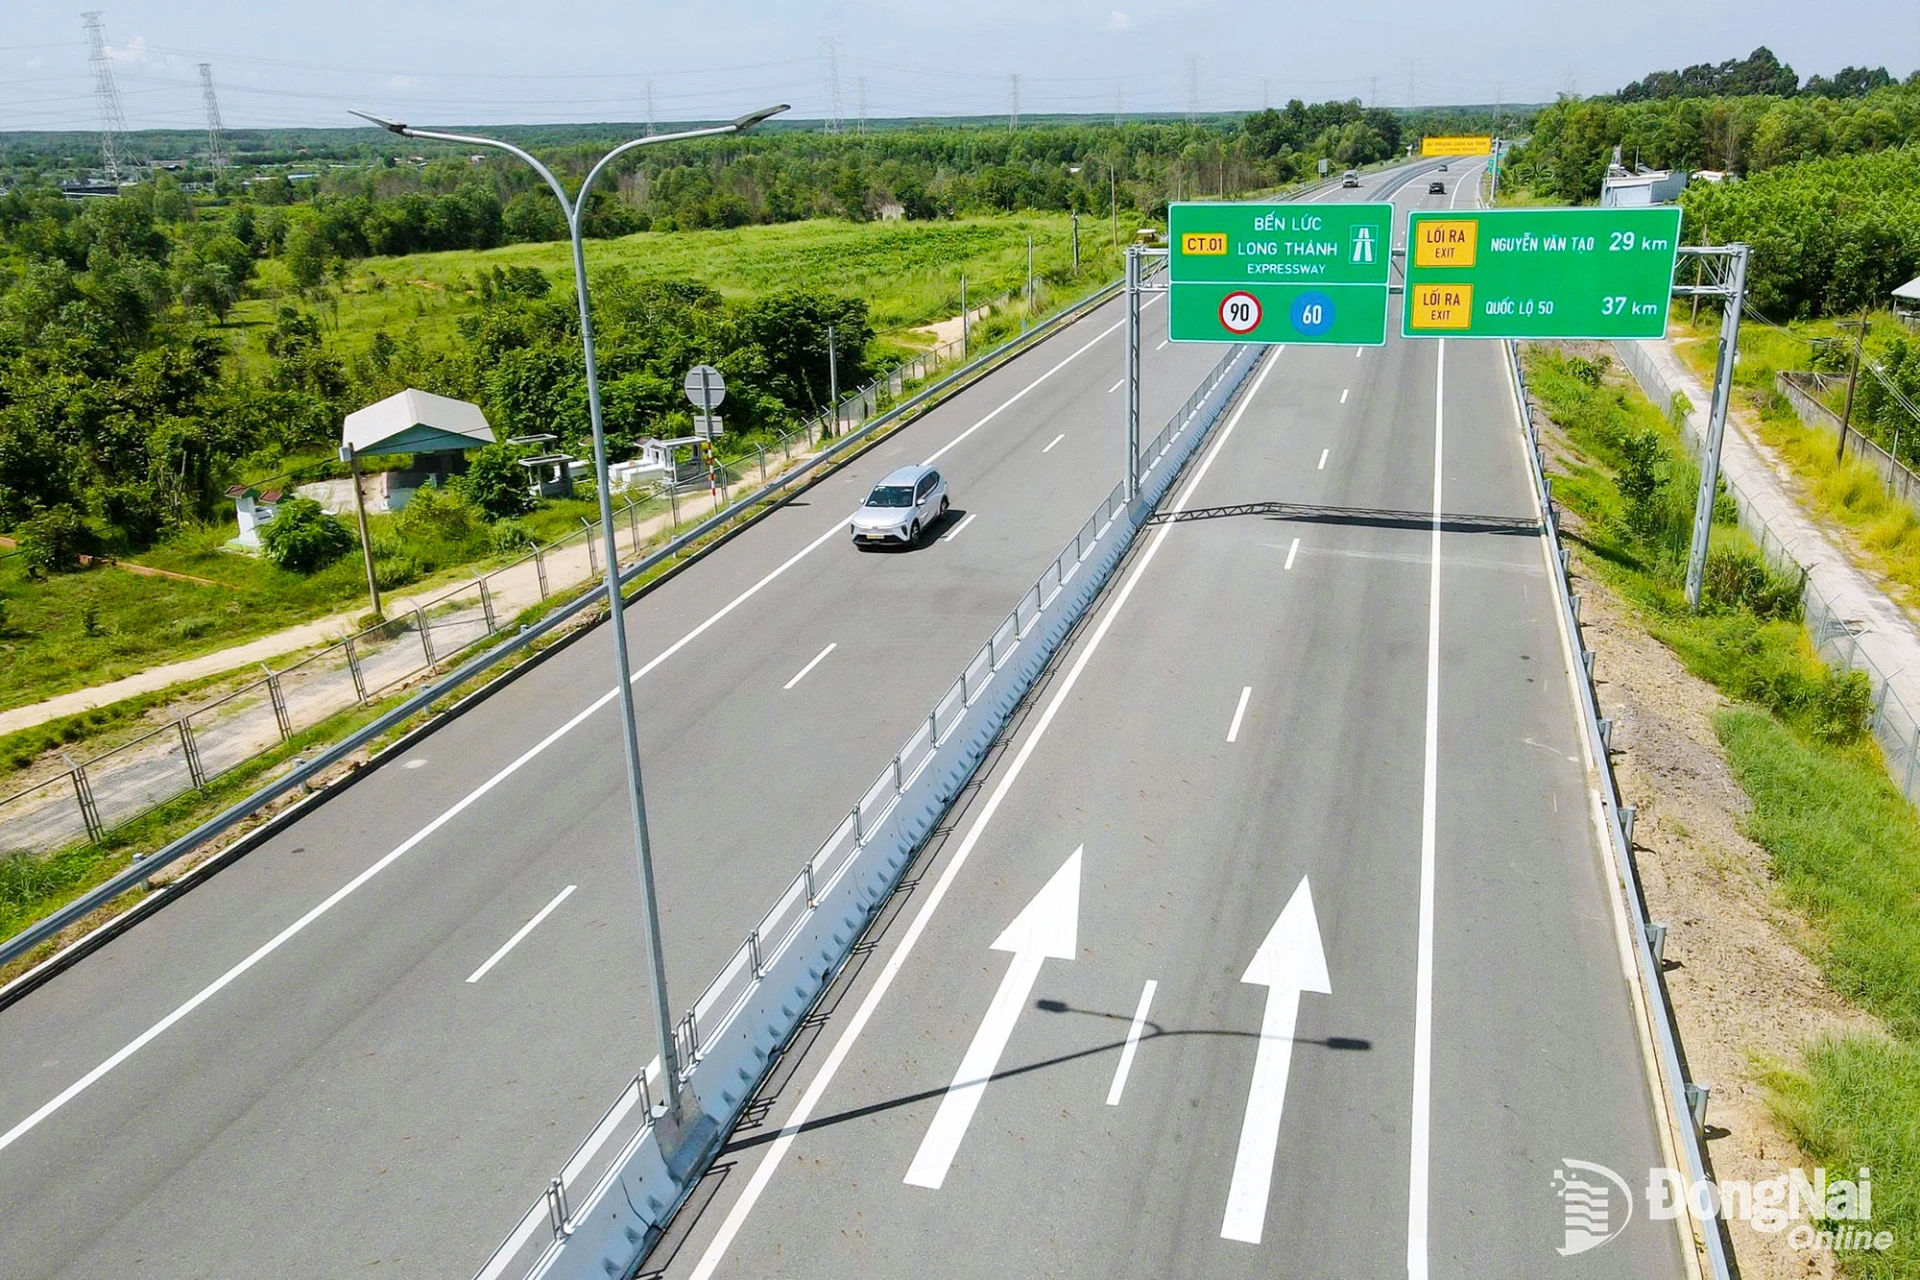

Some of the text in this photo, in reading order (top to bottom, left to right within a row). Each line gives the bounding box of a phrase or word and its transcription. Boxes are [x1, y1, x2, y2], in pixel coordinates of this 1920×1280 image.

[1254, 211, 1322, 231] BẾN LỨC
[1426, 225, 1465, 243] LỐI RA
[1490, 232, 1594, 254] NGUYỄN VĂN TẠO
[1609, 231, 1667, 251] 29 km
[1187, 238, 1223, 251] CT.01
[1237, 239, 1338, 256] LONG THÀNH
[1435, 248, 1455, 259] EXIT
[1247, 263, 1326, 275] EXPRESSWAY
[1423, 288, 1461, 306] LỐI RA
[1601, 296, 1657, 315] 37 km
[1230, 303, 1250, 322] 90
[1302, 305, 1322, 325] 60
[1431, 310, 1450, 321] EXIT
[1485, 296, 1553, 317] QUỐC LỘ 50
